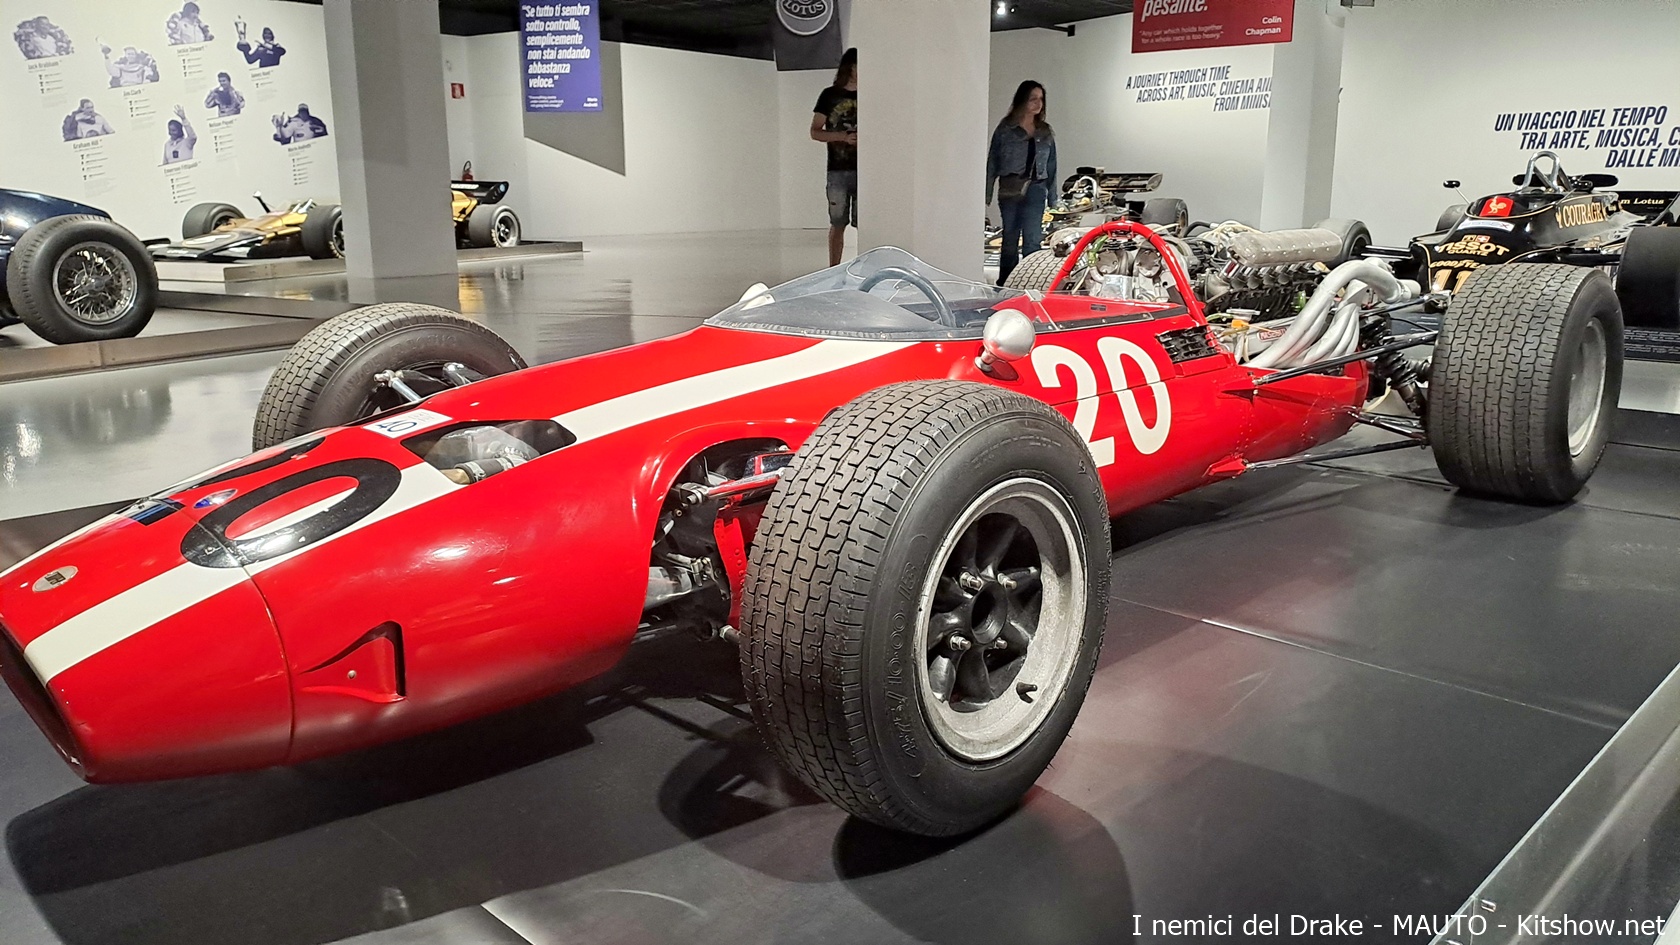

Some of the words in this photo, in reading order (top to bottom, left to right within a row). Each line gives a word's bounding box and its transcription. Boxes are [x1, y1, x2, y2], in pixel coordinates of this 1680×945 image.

[536, 5, 554, 16] tutto
[555, 4, 561, 16] ti
[561, 3, 590, 16] sembra
[784, 0, 824, 15] LOTUS
[1141, 0, 1208, 22] pesante.
[525, 20, 544, 32] sotto
[545, 17, 580, 31] controllo,
[1262, 16, 1282, 25] Colin
[1245, 27, 1281, 36] Chapman
[526, 33, 583, 48] semplicemente
[527, 49, 542, 60] non
[542, 47, 557, 60] stai
[557, 46, 591, 59] andando
[528, 61, 570, 74] abbastanza
[1126, 76, 1132, 89] A
[1132, 72, 1168, 89] JOURNEY
[1168, 68, 1208, 86] THROUGH
[1208, 65, 1231, 81] TIME
[1136, 85, 1167, 103] ACROSS
[1168, 85, 1185, 101] ART,
[1187, 81, 1217, 99] MUSIC,
[1219, 79, 1254, 96] CINEMA
[1213, 95, 1240, 112] FROM
[1494, 113, 1516, 131] UN
[1516, 110, 1577, 130] VIAGGIO
[1577, 109, 1605, 128] NEL
[1610, 106, 1667, 126] TEMPO
[1519, 132, 1549, 150] TRA
[1550, 130, 1589, 150] ARTE,
[1594, 127, 1662, 149] MUSICA,
[1604, 149, 1658, 168] DALLE
[1563, 202, 1604, 228] COURAGE
[1438, 241, 1510, 256] TISSOT
[1031, 336, 1171, 467] 20
[376, 420, 417, 432] 40
